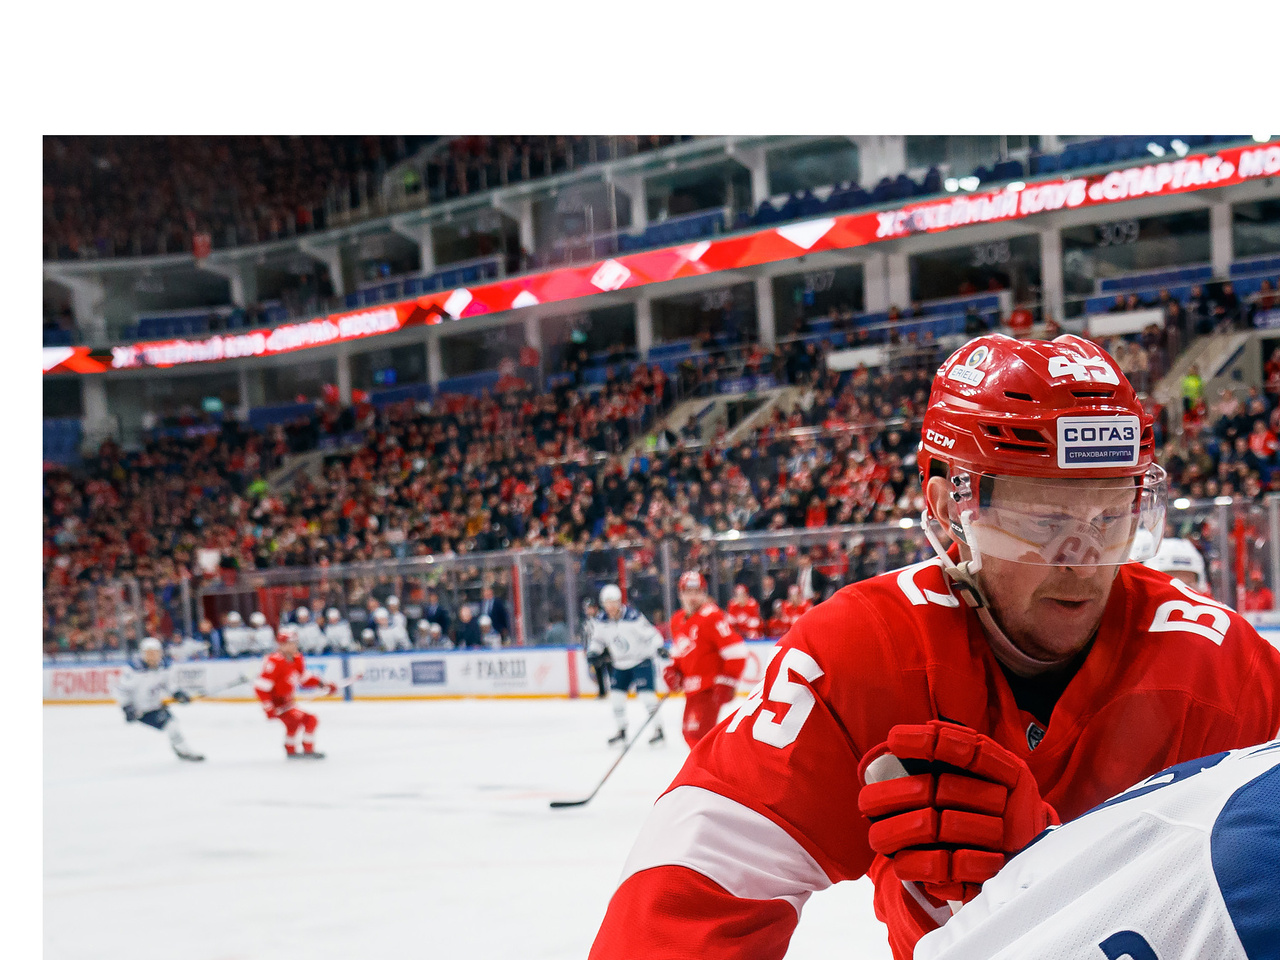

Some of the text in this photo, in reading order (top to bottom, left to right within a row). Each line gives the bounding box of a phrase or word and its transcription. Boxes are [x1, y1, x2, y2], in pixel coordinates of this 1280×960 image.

[1020, 179, 1087, 215] КЛУБ
[951, 367, 979, 383] ERIELL
[1048, 356, 1120, 385] 45
[926, 429, 956, 449] CCM
[1064, 427, 1136, 442] СОГАЗ
[1069, 450, 1132, 459] СТРАХОВАЯ ГРУППА
[726, 646, 826, 749] 45
